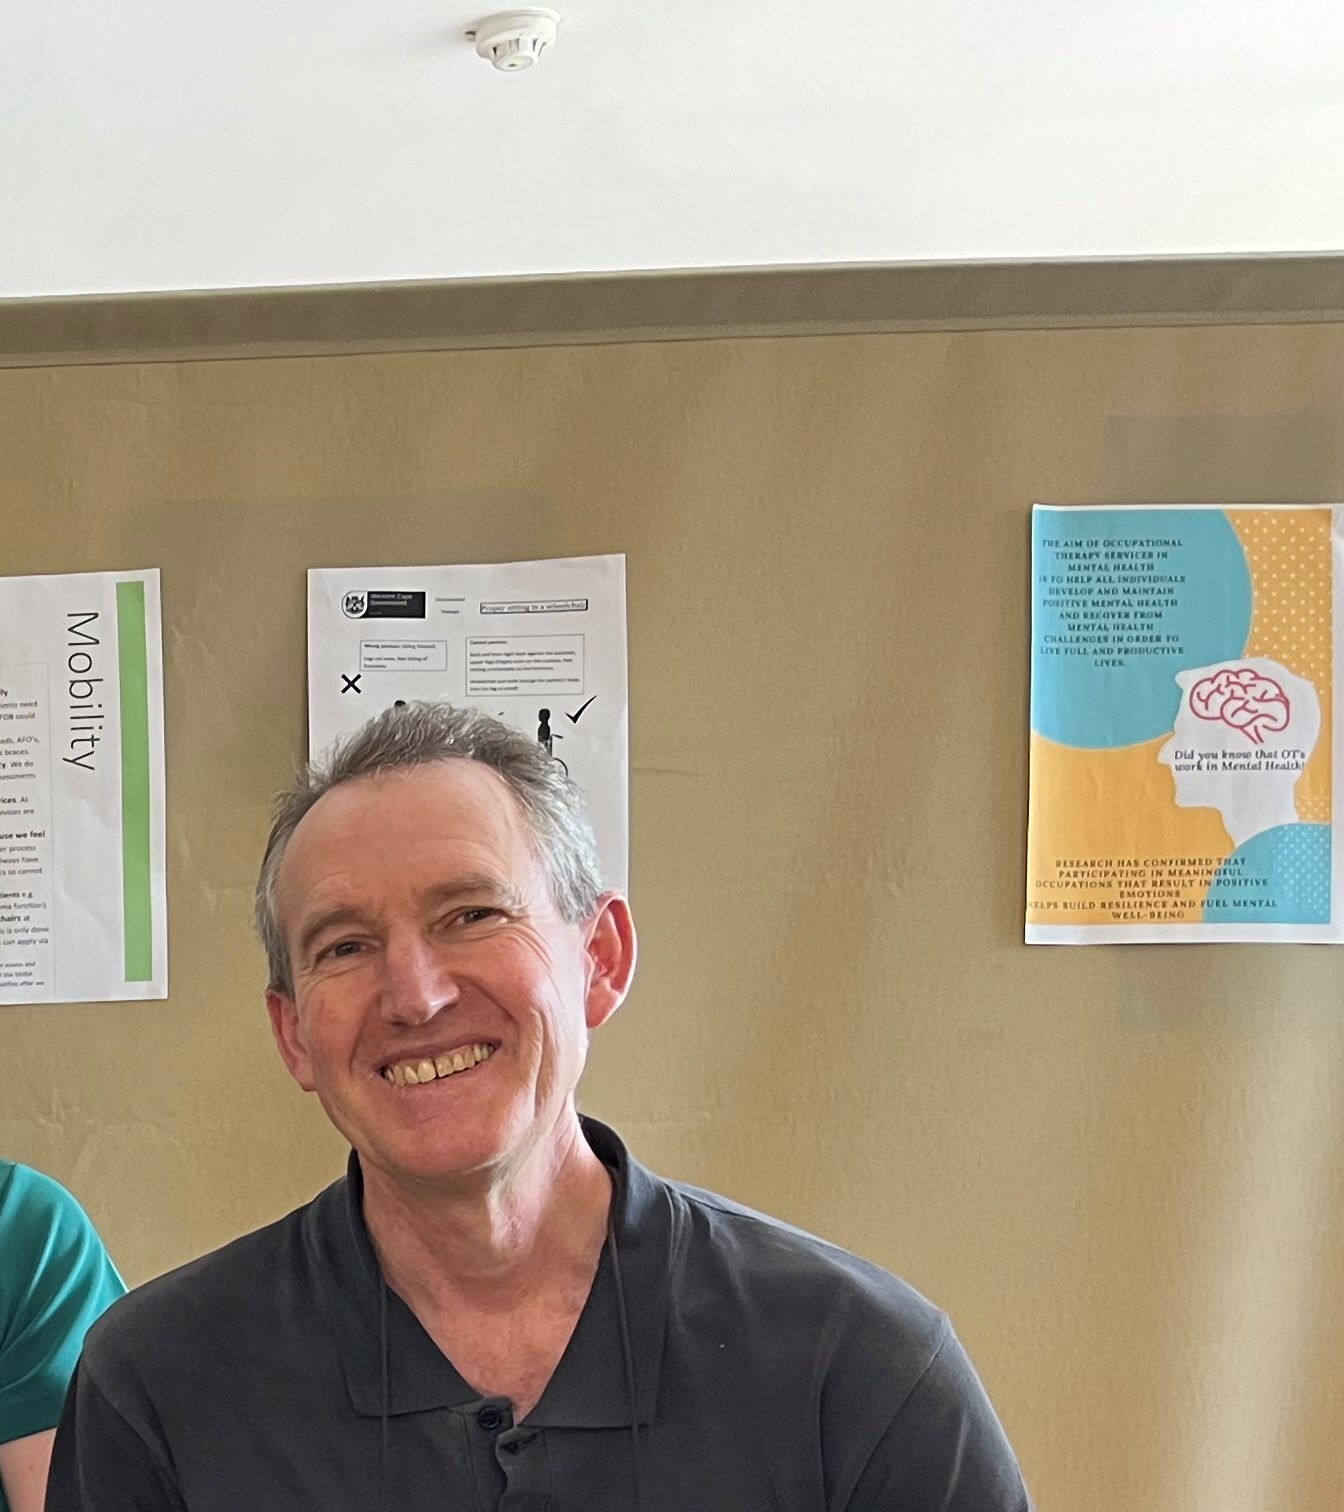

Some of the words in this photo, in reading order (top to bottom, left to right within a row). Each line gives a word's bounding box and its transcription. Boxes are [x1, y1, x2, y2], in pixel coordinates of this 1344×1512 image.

[1103, 539, 1183, 547] OCCUPATIONAL
[1055, 552, 1101, 560] THERAPY
[1118, 575, 1185, 583] INDIVIDUALS
[1122, 587, 1174, 595] MAINTAIN
[1092, 599, 1133, 607] MENTAL
[1137, 599, 1177, 607] HEALTH
[1083, 611, 1129, 619] RECOVER
[1134, 611, 1163, 619] FROM
[1044, 635, 1109, 643] CHALLENGES
[1113, 635, 1123, 643] IN
[1127, 635, 1161, 643] ORDER
[1065, 647, 1089, 655] FULL
[1092, 647, 1114, 655] AND
[1118, 646, 1184, 655] PRODUCTIVE
[62, 612, 104, 771] Mobility
[1175, 750, 1194, 759] Did
[1198, 751, 1218, 760] you
[1222, 750, 1252, 759] know
[1256, 749, 1278, 759] that
[1175, 761, 1202, 771] work
[1207, 761, 1218, 770] in
[1222, 761, 1262, 771] Mental
[1056, 859, 1113, 868] RESEARCH
[1117, 859, 1139, 868] HAS
[1144, 858, 1212, 868] CONFIRMED
[1216, 857, 1246, 866] THAT
[1058, 869, 1146, 878] PARTICIPATING
[1151, 869, 1163, 877] IN
[1168, 868, 1242, 877] MEANINGFUL
[1036, 879, 1113, 888] OCCUPATIONS
[1117, 879, 1146, 888] THAT
[1151, 878, 1195, 888] RESULT
[1199, 878, 1211, 888] IN
[1216, 878, 1268, 887] POSITIVE
[1119, 890, 1181, 899] EMOTIONS
[1063, 901, 1096, 909] BUILD
[1100, 900, 1167, 909] RESILIENCE
[1171, 900, 1196, 908] AND
[1200, 899, 1228, 908] FUEL
[1233, 899, 1278, 908] MENTAL
[1112, 910, 1184, 919] WELL-BEING
